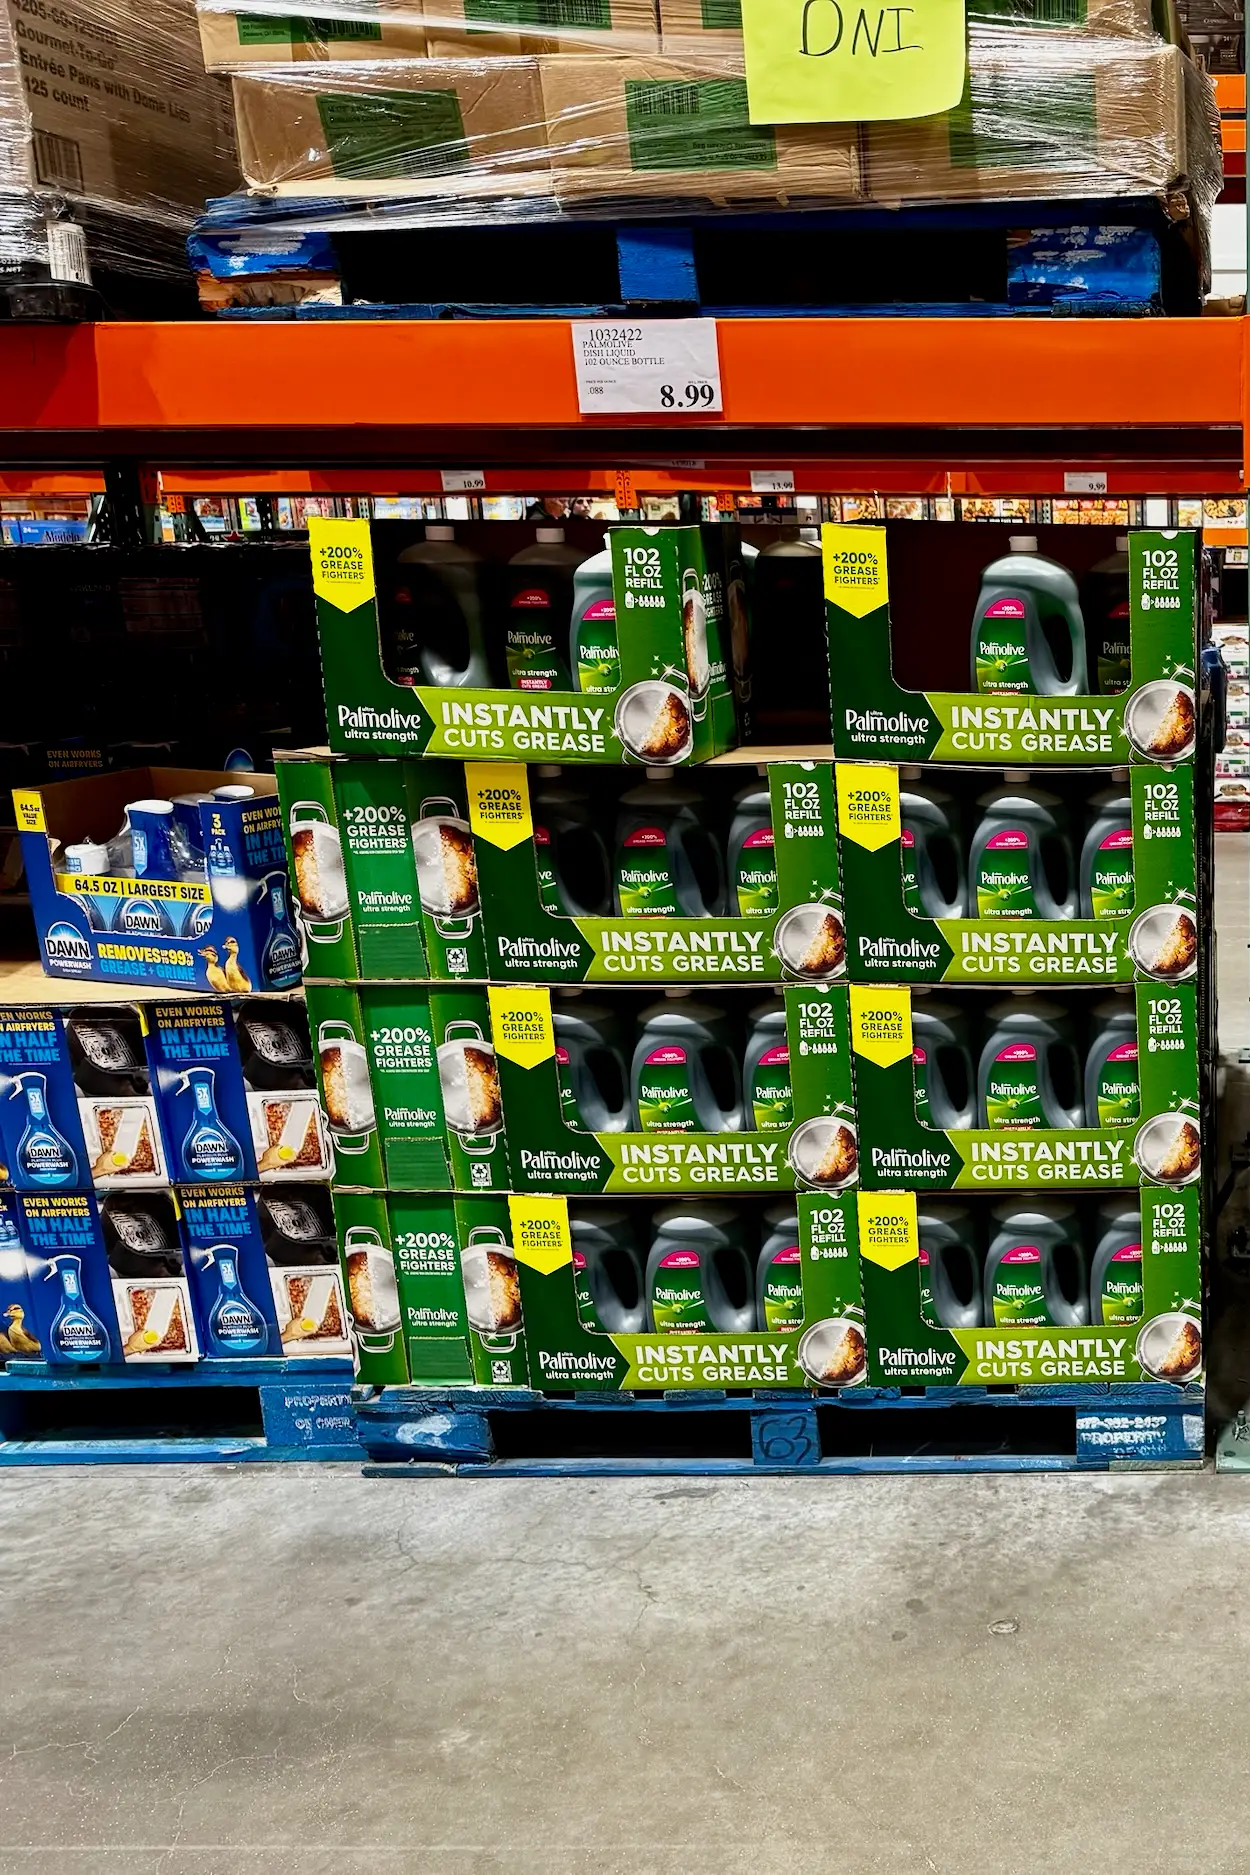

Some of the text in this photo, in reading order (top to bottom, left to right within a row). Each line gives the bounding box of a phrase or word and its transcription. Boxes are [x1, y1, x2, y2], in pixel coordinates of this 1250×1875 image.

[799, 0, 924, 57] DNI
[19, 48, 65, 78] Entrée
[70, 66, 100, 90] Pans
[103, 80, 130, 101] with
[24, 76, 89, 112] 125 count
[589, 329, 642, 341] 1032422
[585, 358, 598, 366] 102
[600, 358, 630, 366] OUNCE
[606, 350, 636, 358] LIQUID
[660, 385, 714, 408] 8.99
[463, 480, 484, 488] 10.99
[772, 482, 793, 490] 13.99
[320, 546, 362, 560] +200%
[623, 548, 660, 566] 102
[832, 552, 878, 566] +200%
[1142, 550, 1178, 568] 102
[320, 560, 364, 571] GREASE
[624, 565, 662, 578] FL OZ
[834, 566, 878, 576] GREASE
[1143, 568, 1179, 580] FL OZ
[625, 577, 664, 589] REFILL
[1143, 578, 1180, 590] REFILL
[337, 704, 421, 730] Palmolive
[442, 702, 605, 732] INSTANTLY
[846, 709, 929, 734] Palmolive
[952, 706, 1112, 731] INSTANTLY
[345, 729, 418, 743] ultra strength
[443, 729, 606, 753] CUTS GREASE
[851, 734, 926, 746] ultra strength
[952, 732, 1112, 752] CUTS GREASE
[343, 806, 406, 824] +200%
[347, 824, 406, 838] GREASE
[74, 879, 204, 900] 64.5 OZ LARGEST SIZE
[46, 939, 91, 960] DAWN
[498, 936, 580, 958] Palmolive
[602, 931, 764, 952] INSTANTLY
[858, 936, 940, 958] Palmolive
[962, 932, 1118, 954] INSTANTLY
[98, 943, 160, 962] REMOVES
[49, 959, 92, 970] POWERWASH
[101, 962, 196, 981] GREASE GRIME
[603, 955, 764, 972] CUTS GREASE
[962, 956, 1117, 974] CUTS GREASE
[156, 1005, 222, 1017] EVEN WORKS
[158, 1016, 225, 1028] ON AIRFRYERS
[161, 1027, 227, 1044] IN HALF
[163, 1042, 230, 1059] THE TIME
[872, 1147, 950, 1168] Palmolive
[972, 1140, 1124, 1162] INSTANTLY
[972, 1162, 1124, 1180] CUTS GREASE
[539, 1351, 616, 1372] Palmolive
[636, 1344, 788, 1364] INSTANTLY
[638, 1366, 788, 1382] CUTS GREASE
[759, 1416, 811, 1464] 63
